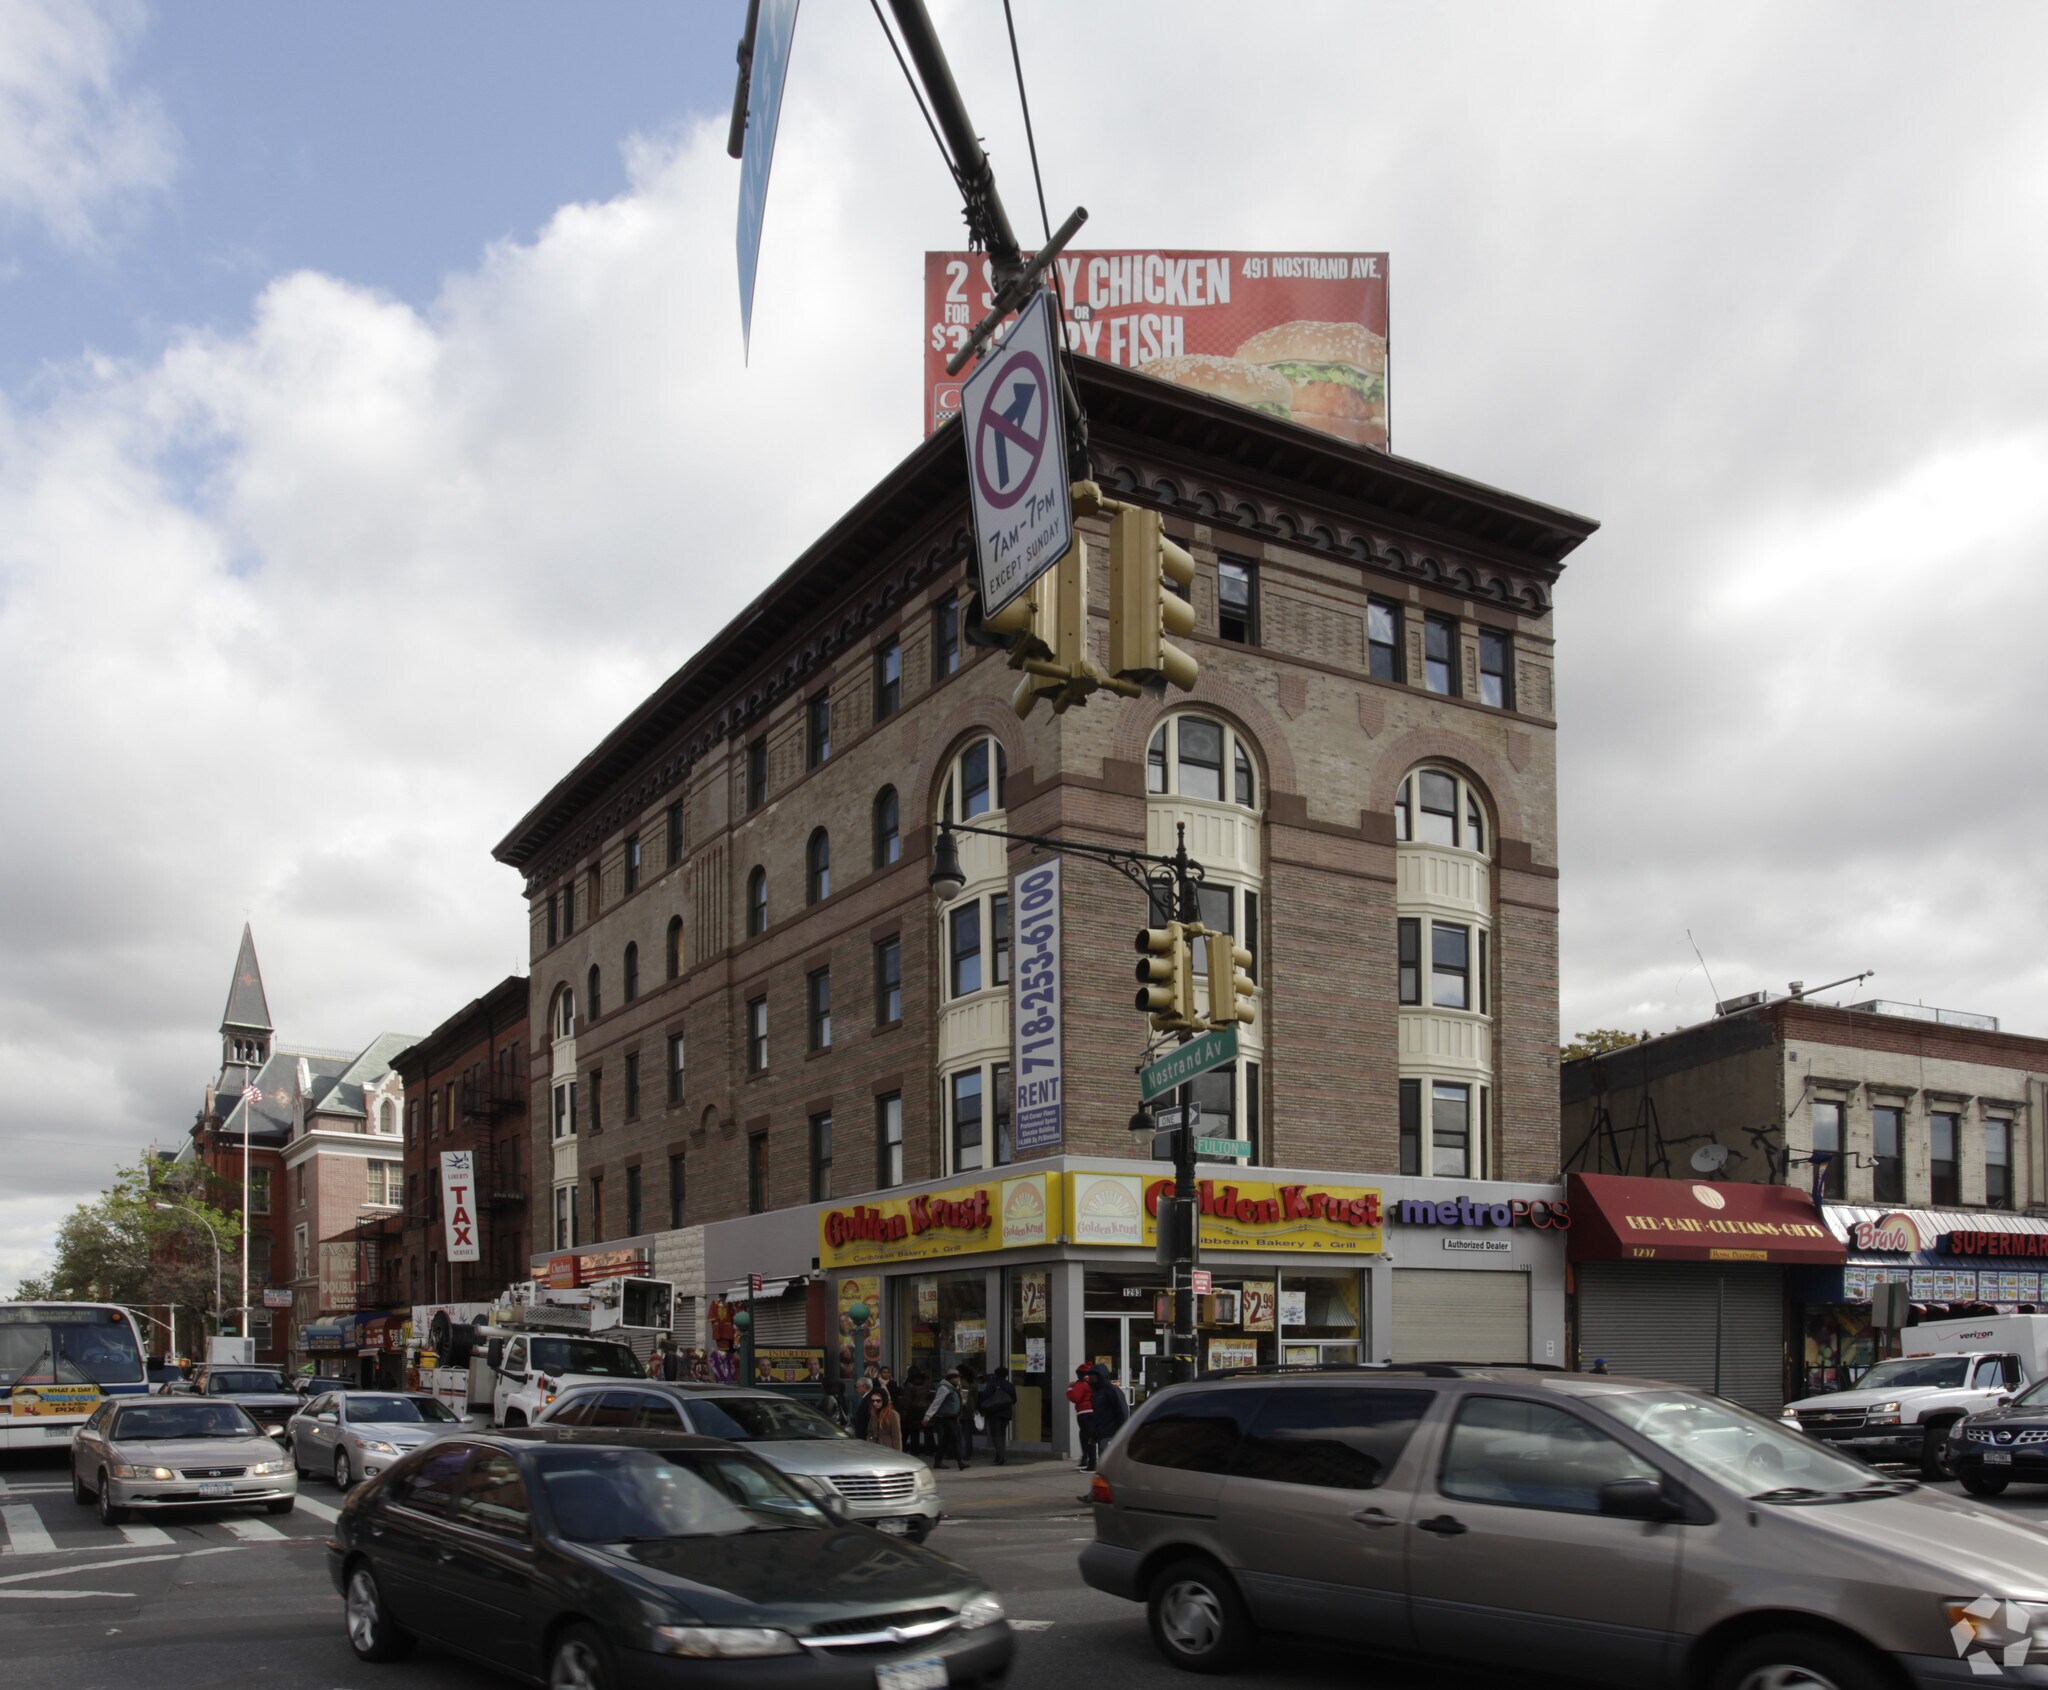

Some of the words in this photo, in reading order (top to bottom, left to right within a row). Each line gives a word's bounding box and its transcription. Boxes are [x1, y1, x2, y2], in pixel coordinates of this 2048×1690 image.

[1242, 257, 1269, 279] 491
[1273, 257, 1348, 280] NOSTRAND
[1351, 258, 1382, 280] AVE.
[946, 261, 969, 302] 2
[1088, 256, 1230, 308] CHICKEN
[945, 304, 970, 324] FOR
[1074, 306, 1090, 320] OR
[1110, 314, 1184, 367] FISH
[990, 555, 1022, 595] EXCEPT
[1026, 518, 1060, 562] SUNDAY
[1020, 870, 1055, 1076] 718-253-6100
[1148, 1048, 1202, 1090] Nostrand
[1205, 1039, 1222, 1061] Av
[1018, 1077, 1060, 1109] RENT
[1161, 1115, 1176, 1127] ONE
[1199, 1139, 1239, 1155] FULTON
[1145, 1179, 1281, 1224] Glden
[1279, 1185, 1384, 1228] Krust
[1401, 1195, 1572, 1231] metroPCS
[450, 1186, 472, 1246] TAX
[824, 1205, 909, 1249] Golden
[908, 1189, 993, 1237] Krust
[1003, 1225, 1025, 1238] Golden
[1024, 1223, 1044, 1235] Krust
[1076, 1220, 1111, 1235] Golden
[1111, 1221, 1138, 1236] Krust
[1856, 1222, 1907, 1251] Bravo
[853, 1252, 895, 1262] Caribbean
[897, 1249, 929, 1259] Bakery
[1256, 1239, 1305, 1249] Bakery
[1329, 1241, 1356, 1249] Grill
[1447, 1240, 1485, 1250] Authorized
[1486, 1242, 1509, 1251] Dealer
[1519, 1263, 1532, 1271] 1295
[1124, 1288, 1142, 1297] 1293
[1243, 1289, 1274, 1325] $2.99
[1959, 1330, 1993, 1340] verizon
